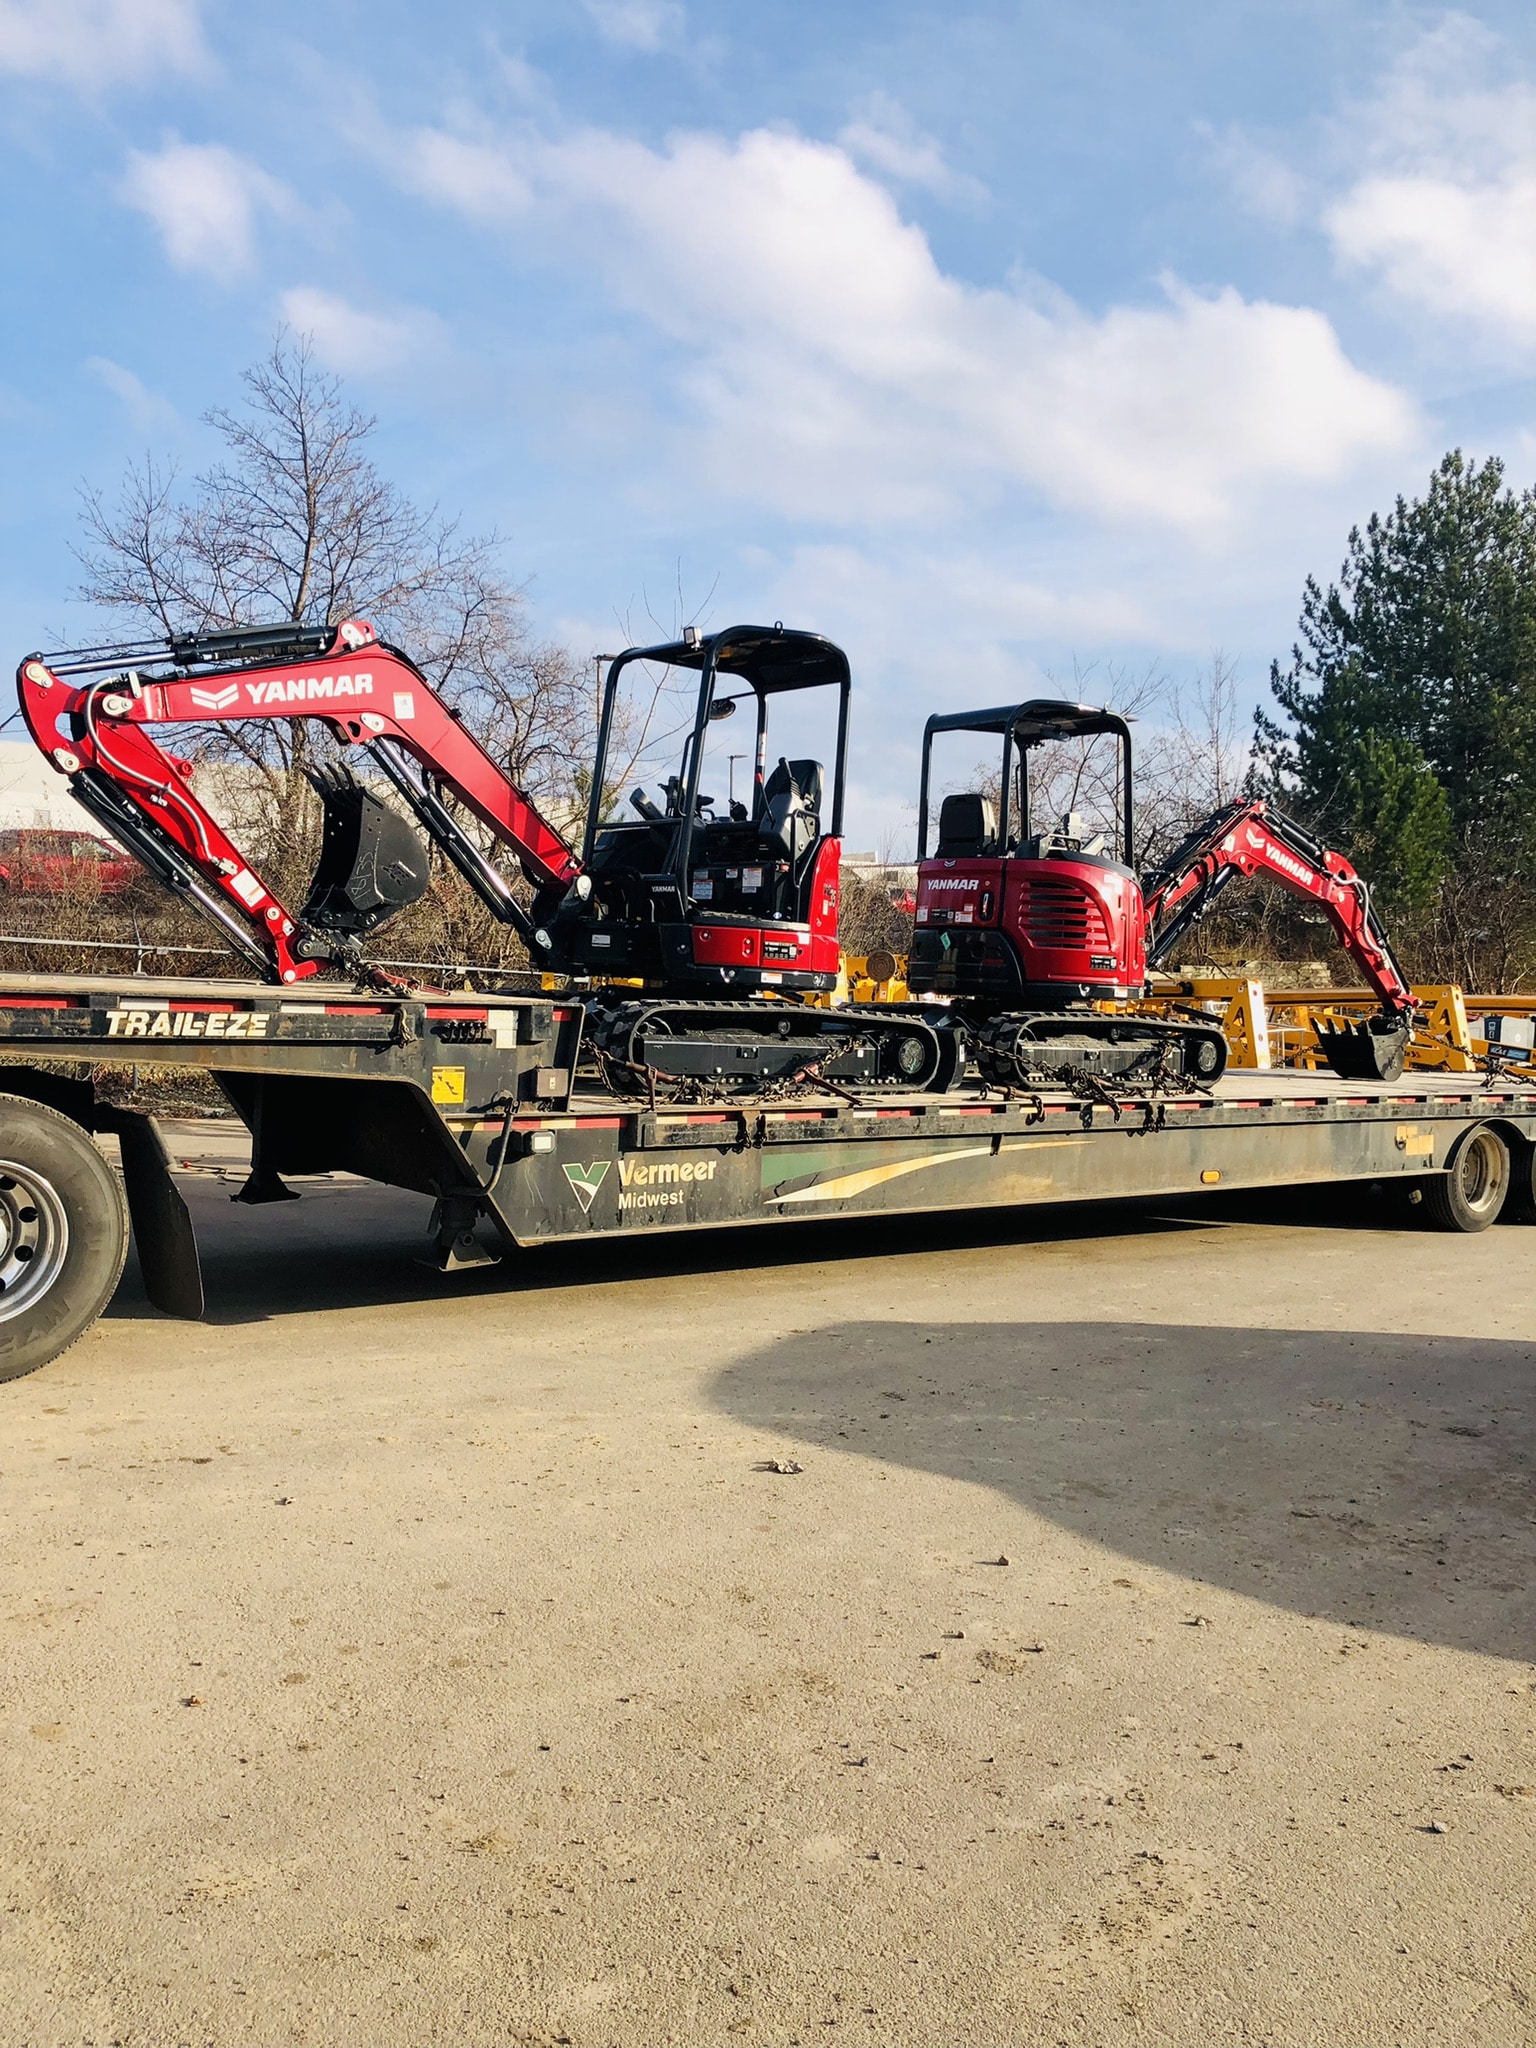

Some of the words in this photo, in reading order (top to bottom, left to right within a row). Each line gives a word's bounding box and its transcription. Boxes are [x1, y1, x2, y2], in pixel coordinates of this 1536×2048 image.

[245, 673, 373, 704] YANMAR
[1265, 842, 1314, 886] YANMAR
[651, 885, 675, 893] YANMAR
[927, 879, 979, 890] YANMAR
[617, 1159, 717, 1187] Vermeer
[618, 1189, 684, 1210] Midwest
